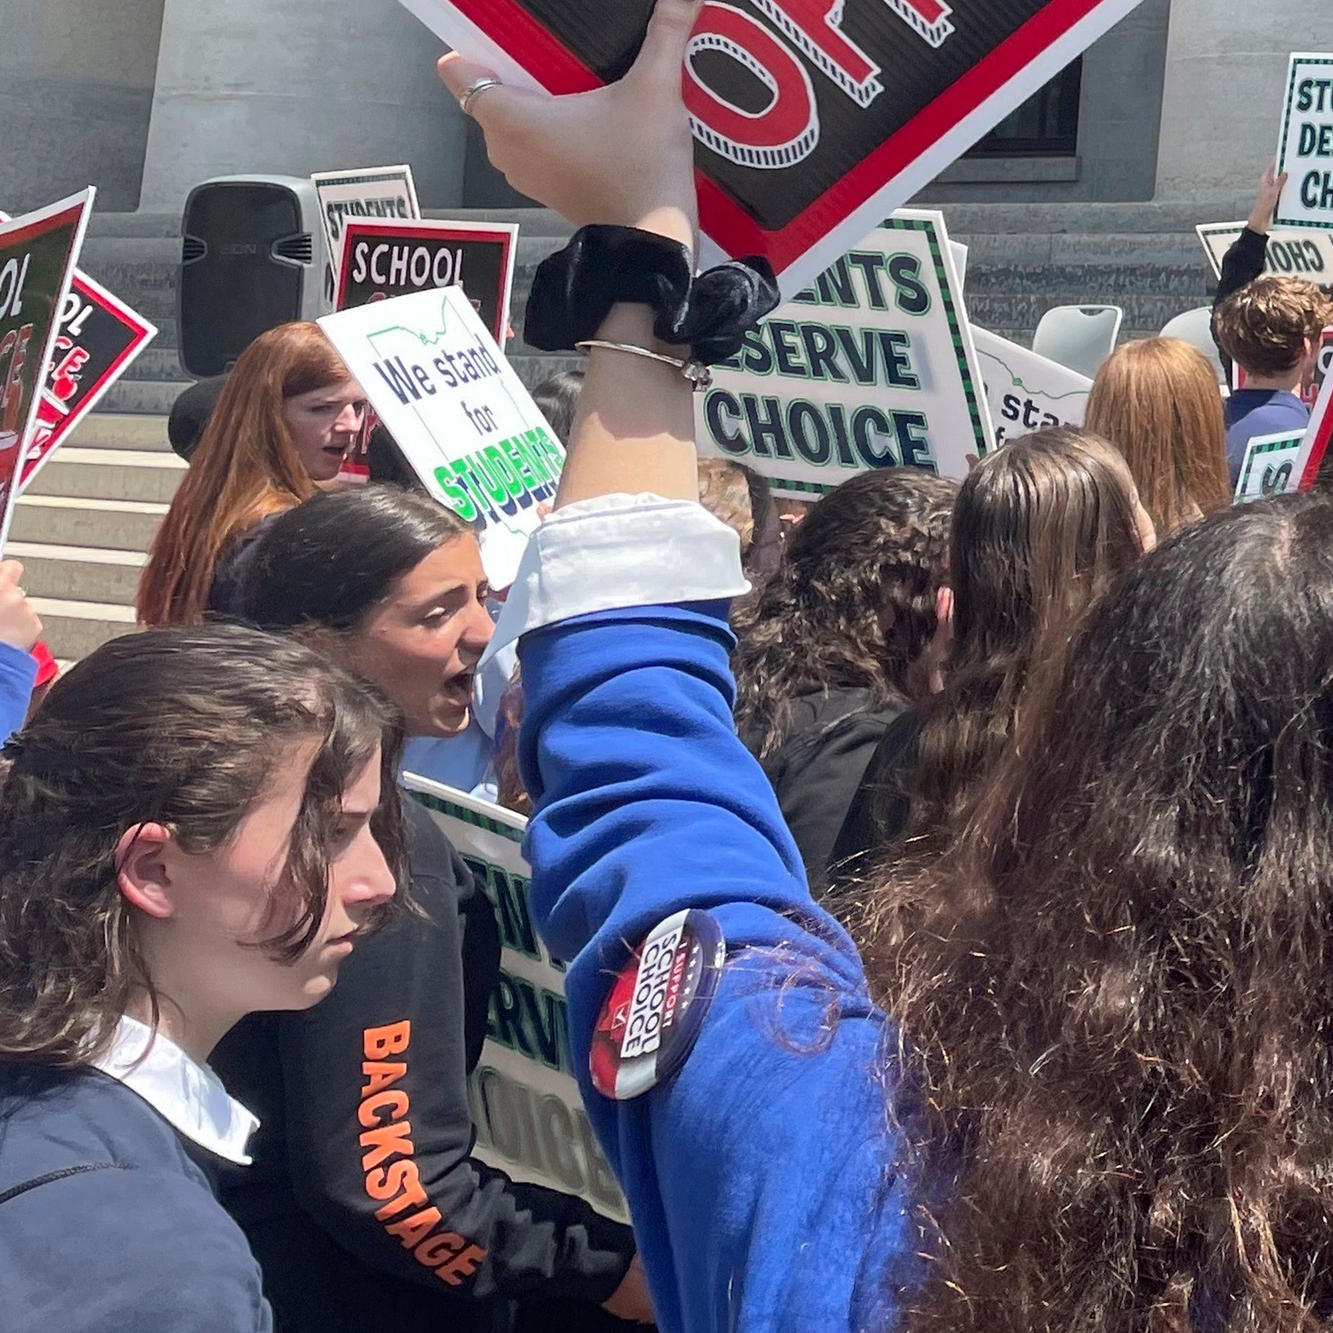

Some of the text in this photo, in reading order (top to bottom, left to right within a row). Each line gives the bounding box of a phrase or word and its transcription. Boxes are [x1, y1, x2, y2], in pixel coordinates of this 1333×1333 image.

[352, 241, 464, 287] SCHOOL
[371, 333, 503, 406] We stand
[460, 400, 499, 436] for
[703, 387, 940, 475] CHOICE
[625, 943, 660, 1053] CHOICE
[641, 932, 678, 1051] SCHOOL
[662, 952, 688, 1028] SUPPORT
[358, 1019, 487, 1286] BACKSTAGE
